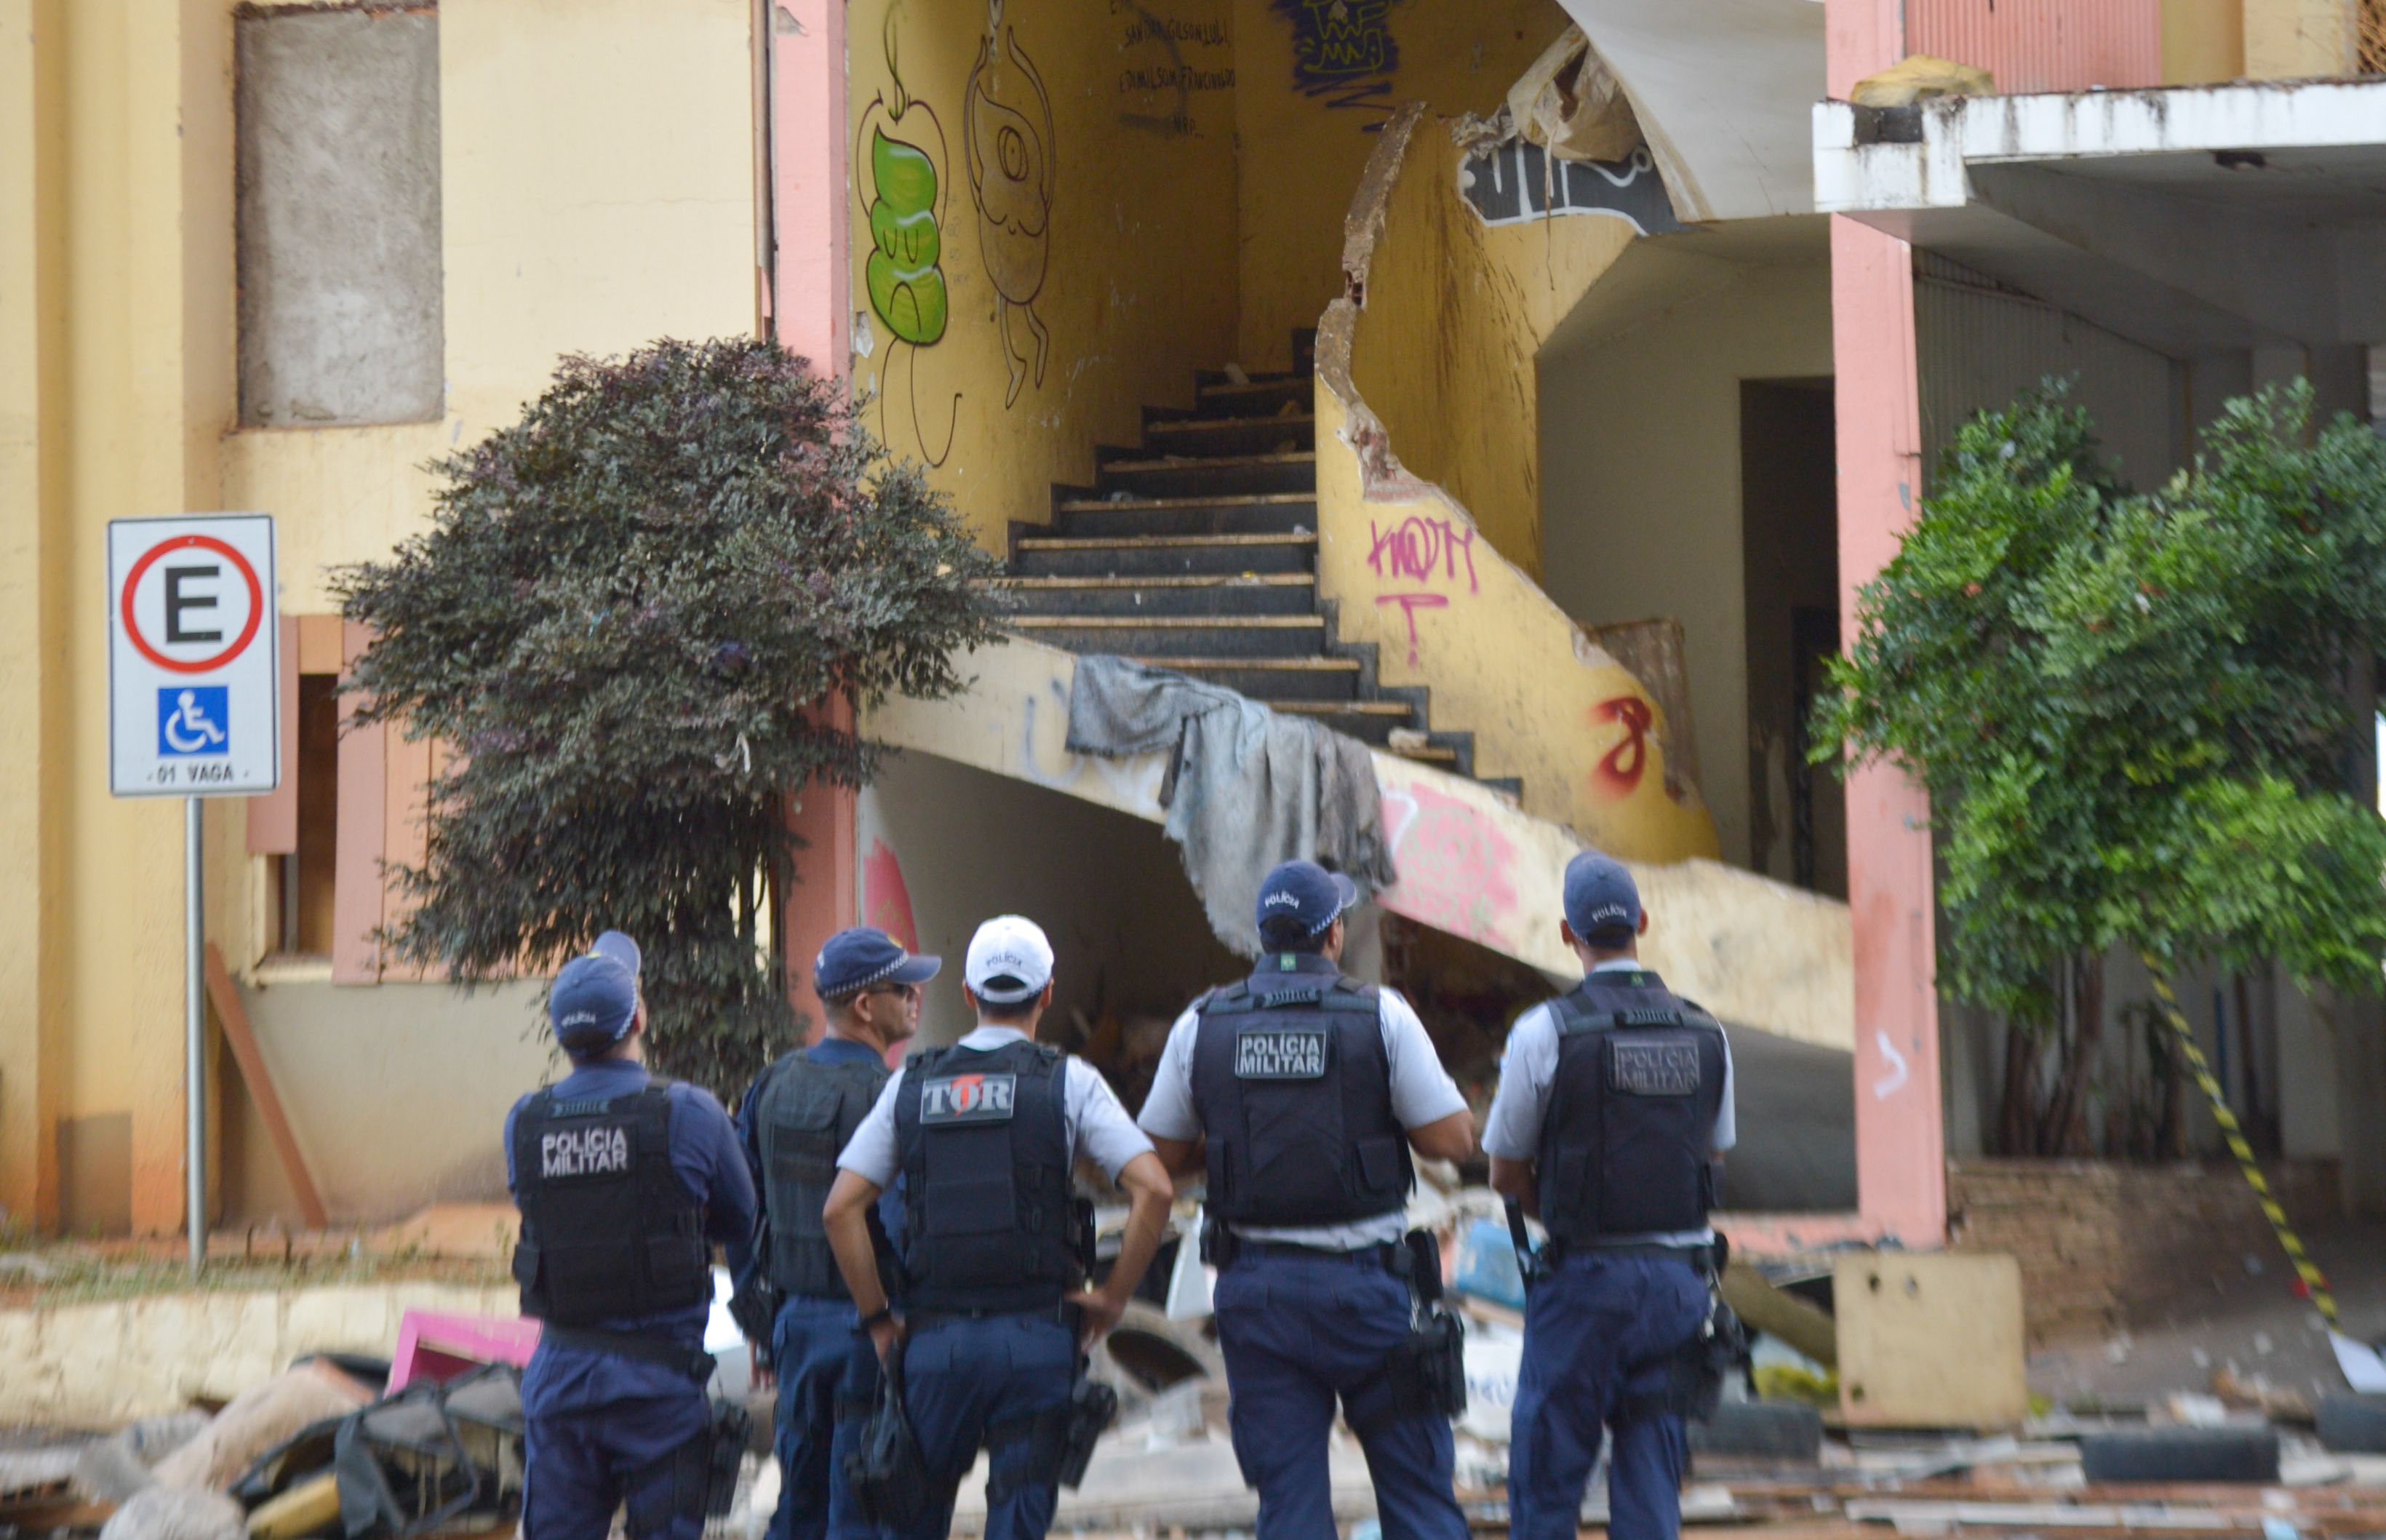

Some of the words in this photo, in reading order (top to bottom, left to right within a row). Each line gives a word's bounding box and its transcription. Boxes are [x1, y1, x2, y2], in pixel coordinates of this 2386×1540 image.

[166, 566, 222, 643] E
[157, 765, 175, 784] 01
[188, 765, 234, 783] VAGA
[1240, 1054, 1320, 1074] MILITAR
[1621, 1069, 1696, 1089] MILITAR
[923, 1077, 1013, 1116] TOR
[542, 1151, 628, 1178] MILITAR
